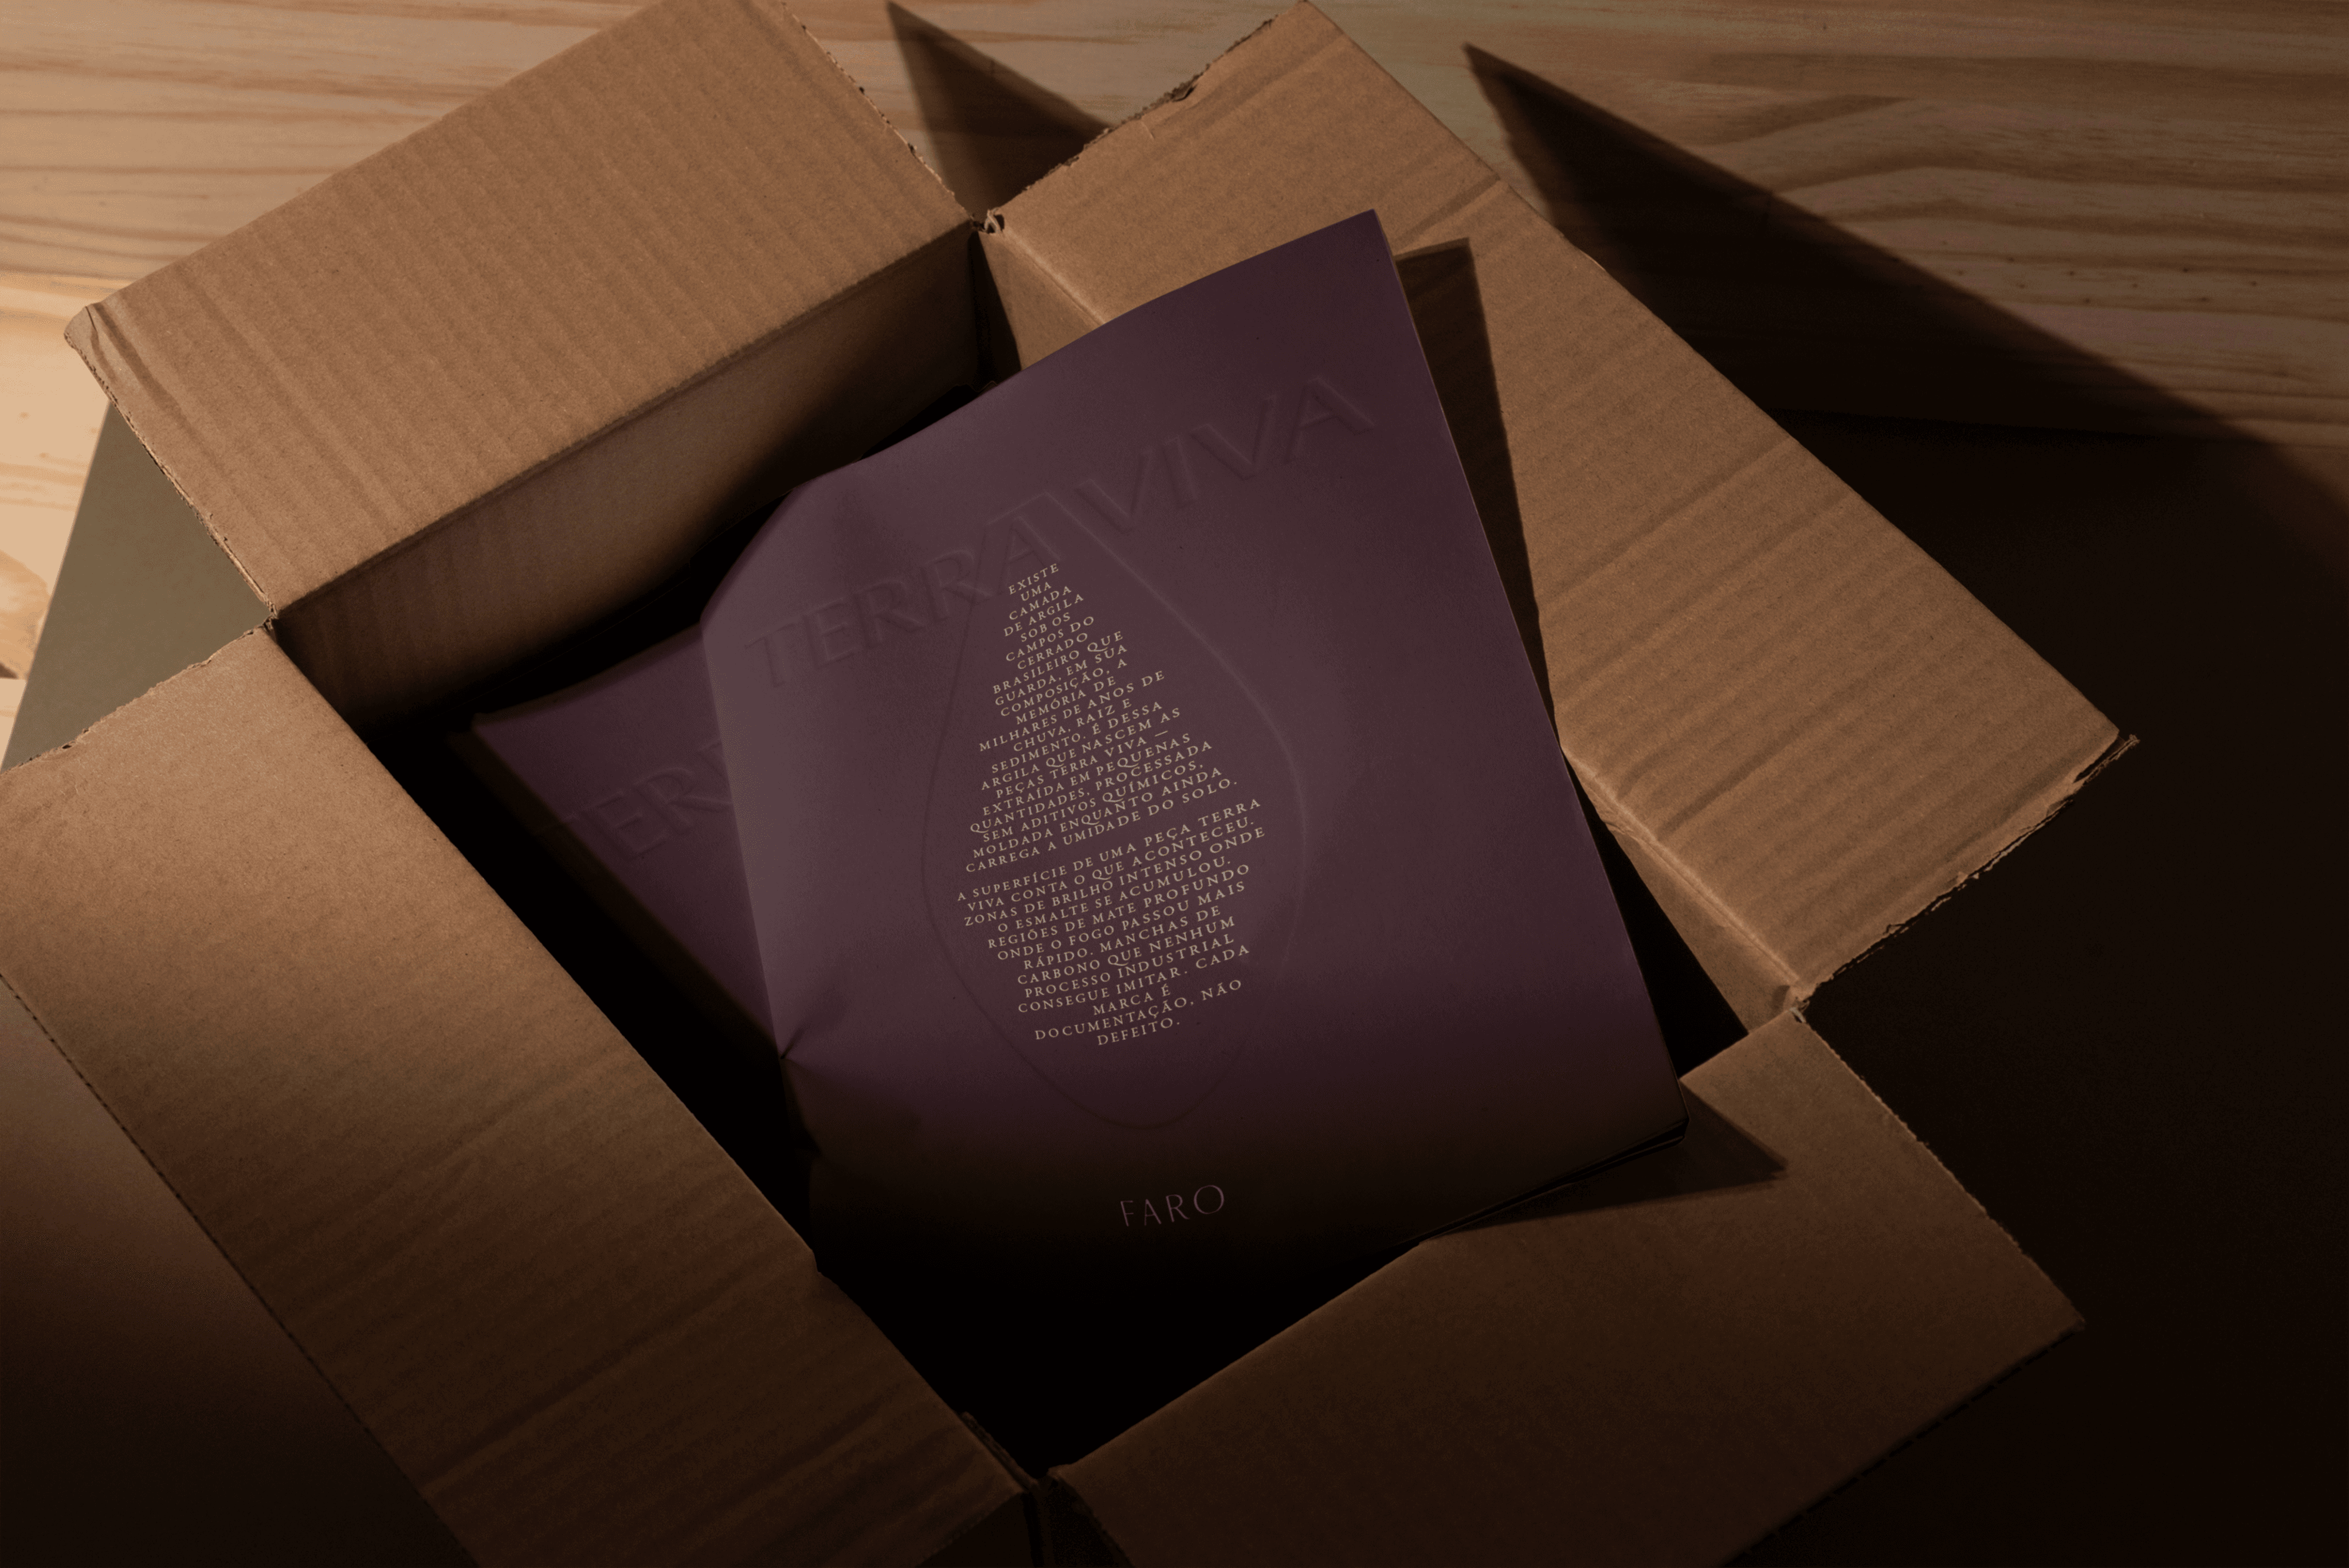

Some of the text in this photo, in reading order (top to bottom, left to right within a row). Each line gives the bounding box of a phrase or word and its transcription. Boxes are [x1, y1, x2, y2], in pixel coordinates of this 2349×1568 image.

[743, 375, 1375, 688] TERRA VIVA
[1008, 563, 1059, 595] EXISTE
[1009, 585, 1072, 620] CAMADA
[1020, 581, 1052, 601] UMA
[1003, 594, 1084, 637] DE ARGILA
[1005, 616, 1094, 662] CAMPOS DO
[1020, 612, 1071, 642] SOB OS
[993, 631, 1123, 694] BRASILEIRO QUE
[995, 644, 1128, 706] GUARDA, EM SUA
[1017, 632, 1088, 670] CERRADO
[979, 670, 1165, 752] MILHARES DE ANOS DE
[1000, 658, 1128, 717] COMPOSIÇÃO, A
[1015, 676, 1116, 725] MEMÓRIA DE
[981, 707, 1180, 790] ARGILA QUE NASCEM AS
[992, 701, 1162, 774] SEDIMENTO. É DESSA
[1013, 698, 1132, 752] CHUVA, RAIZ E
[970, 741, 1213, 833] QUANTIDADES, PROCESSADA
[982, 733, 1191, 816] EXTRAÍDA EM PEQUENAS
[996, 774, 1044, 799] PEÇAS
[1049, 754, 1098, 779] TERRA
[1104, 736, 1147, 757] VIVA
[966, 778, 1238, 872] CARREGA A UMIDADE DO SOLO.
[973, 767, 1222, 858] MOLDADA ENQUANTO AINDA
[983, 760, 1203, 842] SEM ADITIVOS QUÍMICOS,
[957, 799, 1261, 901] A SUPERFÍCIE DE UMA PEÇA TERRA
[964, 827, 1265, 926] ZONAS DE BRILHO INTENSO ONDE
[967, 816, 1254, 911] VIVA CONTA O QUE ACONTECEU.
[988, 864, 1249, 948] REGIÕES DE MATE PROFUNDO
[997, 880, 1245, 960] ONDE O FOGO PASSOU MAIS
[998, 856, 1231, 932] O ESMALTE SE ACUMULOU.
[1017, 916, 1235, 984] CARBONO QUE NENHUM
[1024, 905, 1221, 970] RÁPIDO. MANCHAS DE
[1025, 934, 1234, 998] PROCESSO INDUSTRIAL
[1018, 945, 1250, 1013] CONSEGUE IMITAR. CADA
[1035, 979, 1241, 1040] DOCUMENTAÇÃO, NÃO
[1093, 983, 1171, 1015] MARCA É
[1097, 1018, 1180, 1046] DEFEITO.
[1120, 1184, 1225, 1227] FARO
